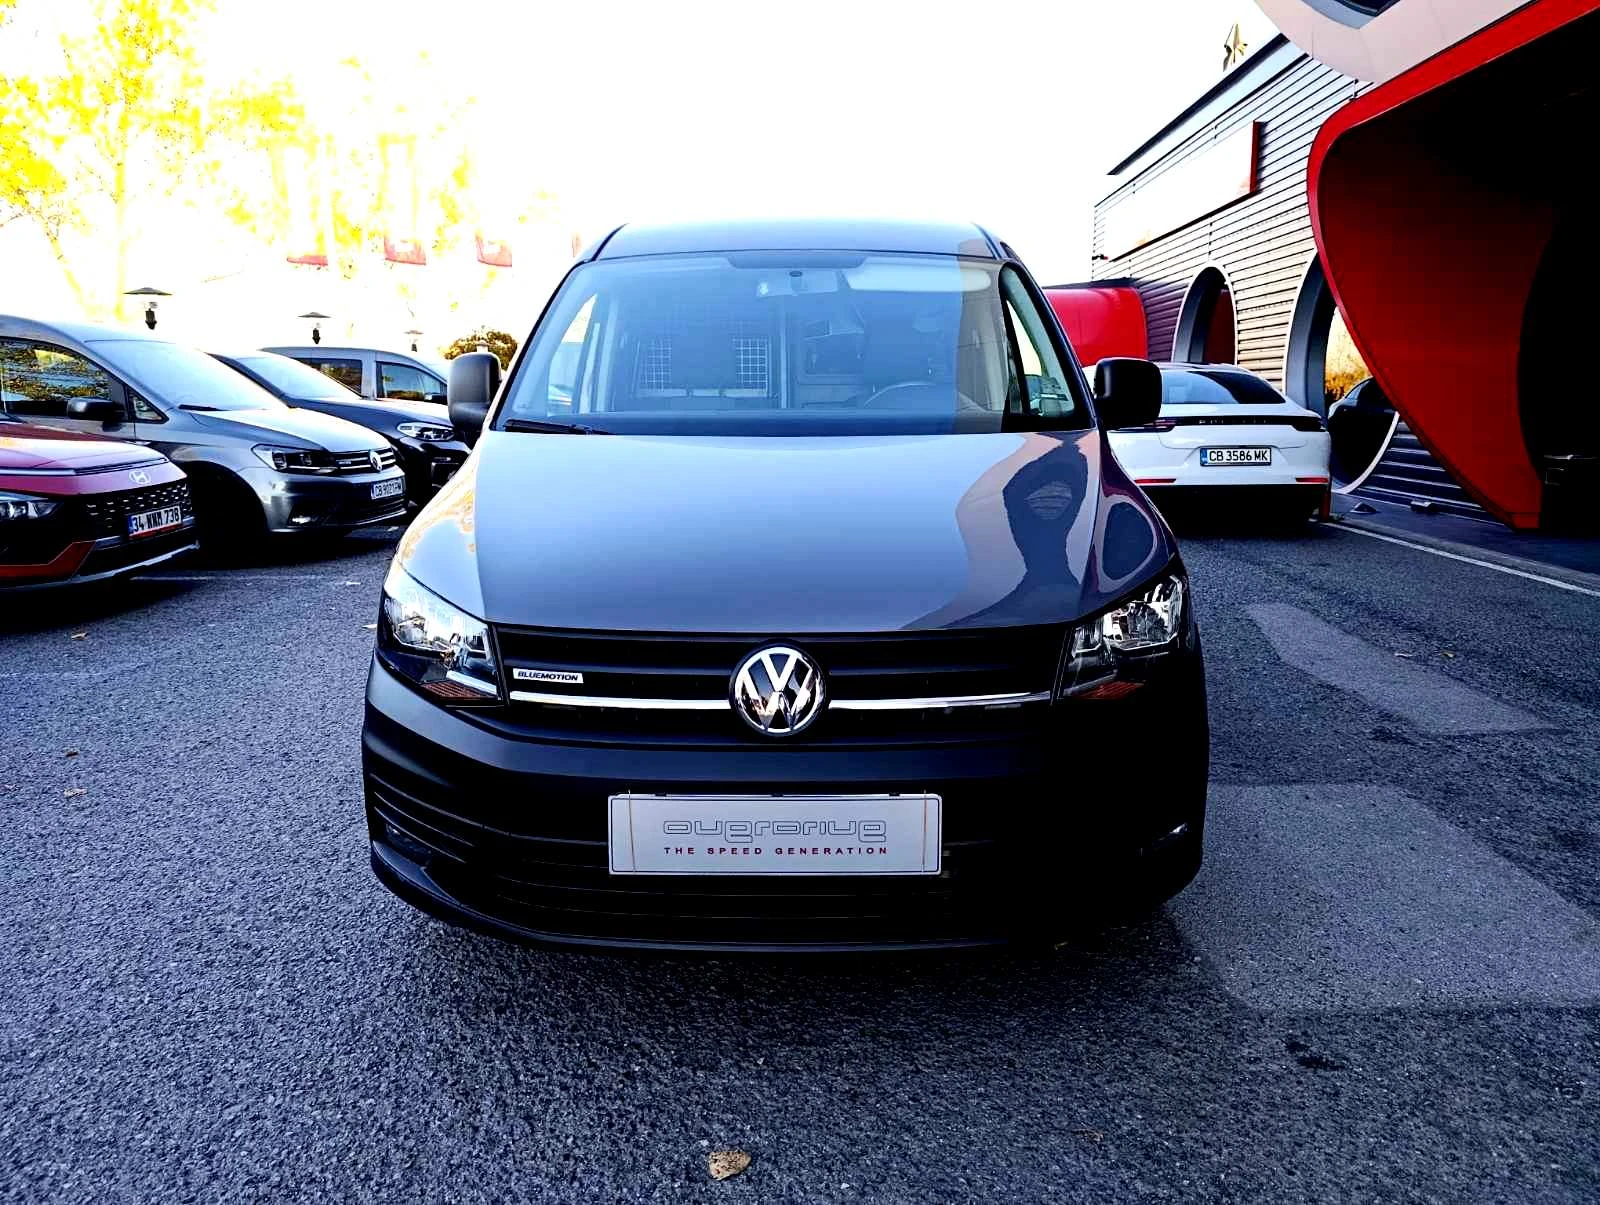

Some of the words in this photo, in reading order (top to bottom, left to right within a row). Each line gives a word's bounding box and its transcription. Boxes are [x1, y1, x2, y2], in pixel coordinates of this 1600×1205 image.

[1226, 450, 1252, 461] 3586
[1254, 450, 1268, 461] MK
[132, 515, 144, 532] 34
[164, 507, 179, 524] 738
[518, 670, 579, 681] BLUEMOTION
[663, 847, 695, 855] THE
[707, 847, 762, 855] SPEED
[775, 847, 887, 855] GENERATION
